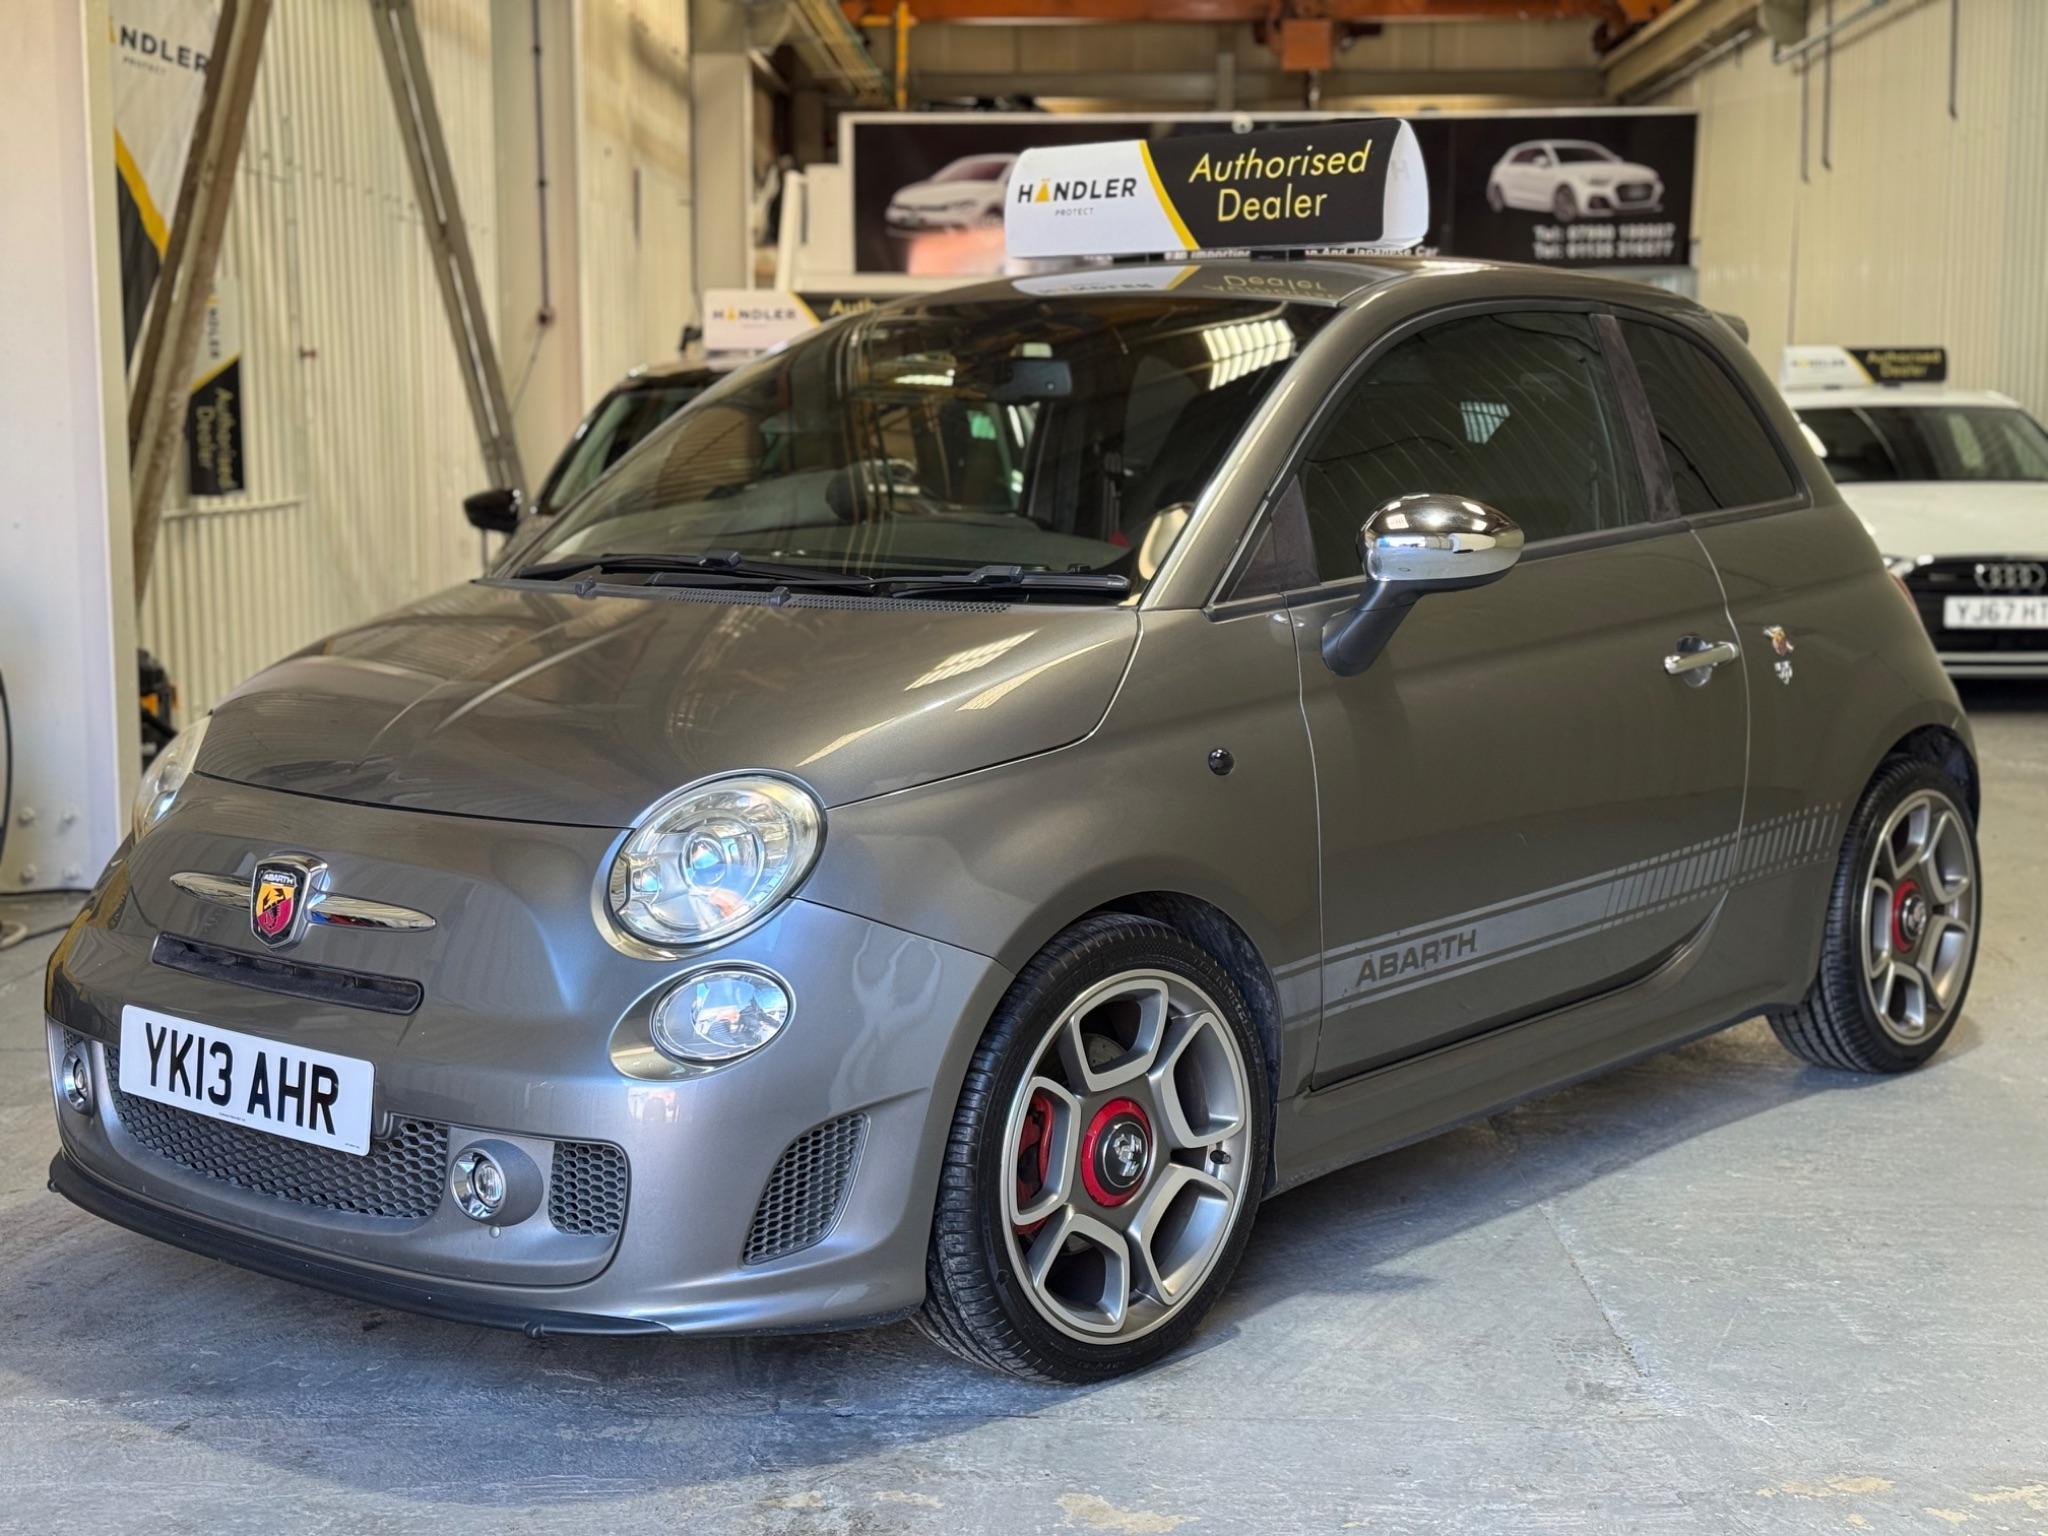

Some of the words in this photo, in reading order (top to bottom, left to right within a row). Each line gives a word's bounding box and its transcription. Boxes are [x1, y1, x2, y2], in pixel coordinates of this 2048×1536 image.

[109, 16, 209, 73] NDLER
[1189, 139, 1372, 183] Authorised
[1017, 177, 1137, 203] HÄNDLER
[1218, 183, 1328, 222] Dealer
[1055, 206, 1095, 216] PROTECT
[263, 873, 293, 885] ABARTH
[1355, 929, 1478, 988] ABARTH
[145, 1022, 233, 1107] YK13
[247, 1051, 339, 1136] AHR
